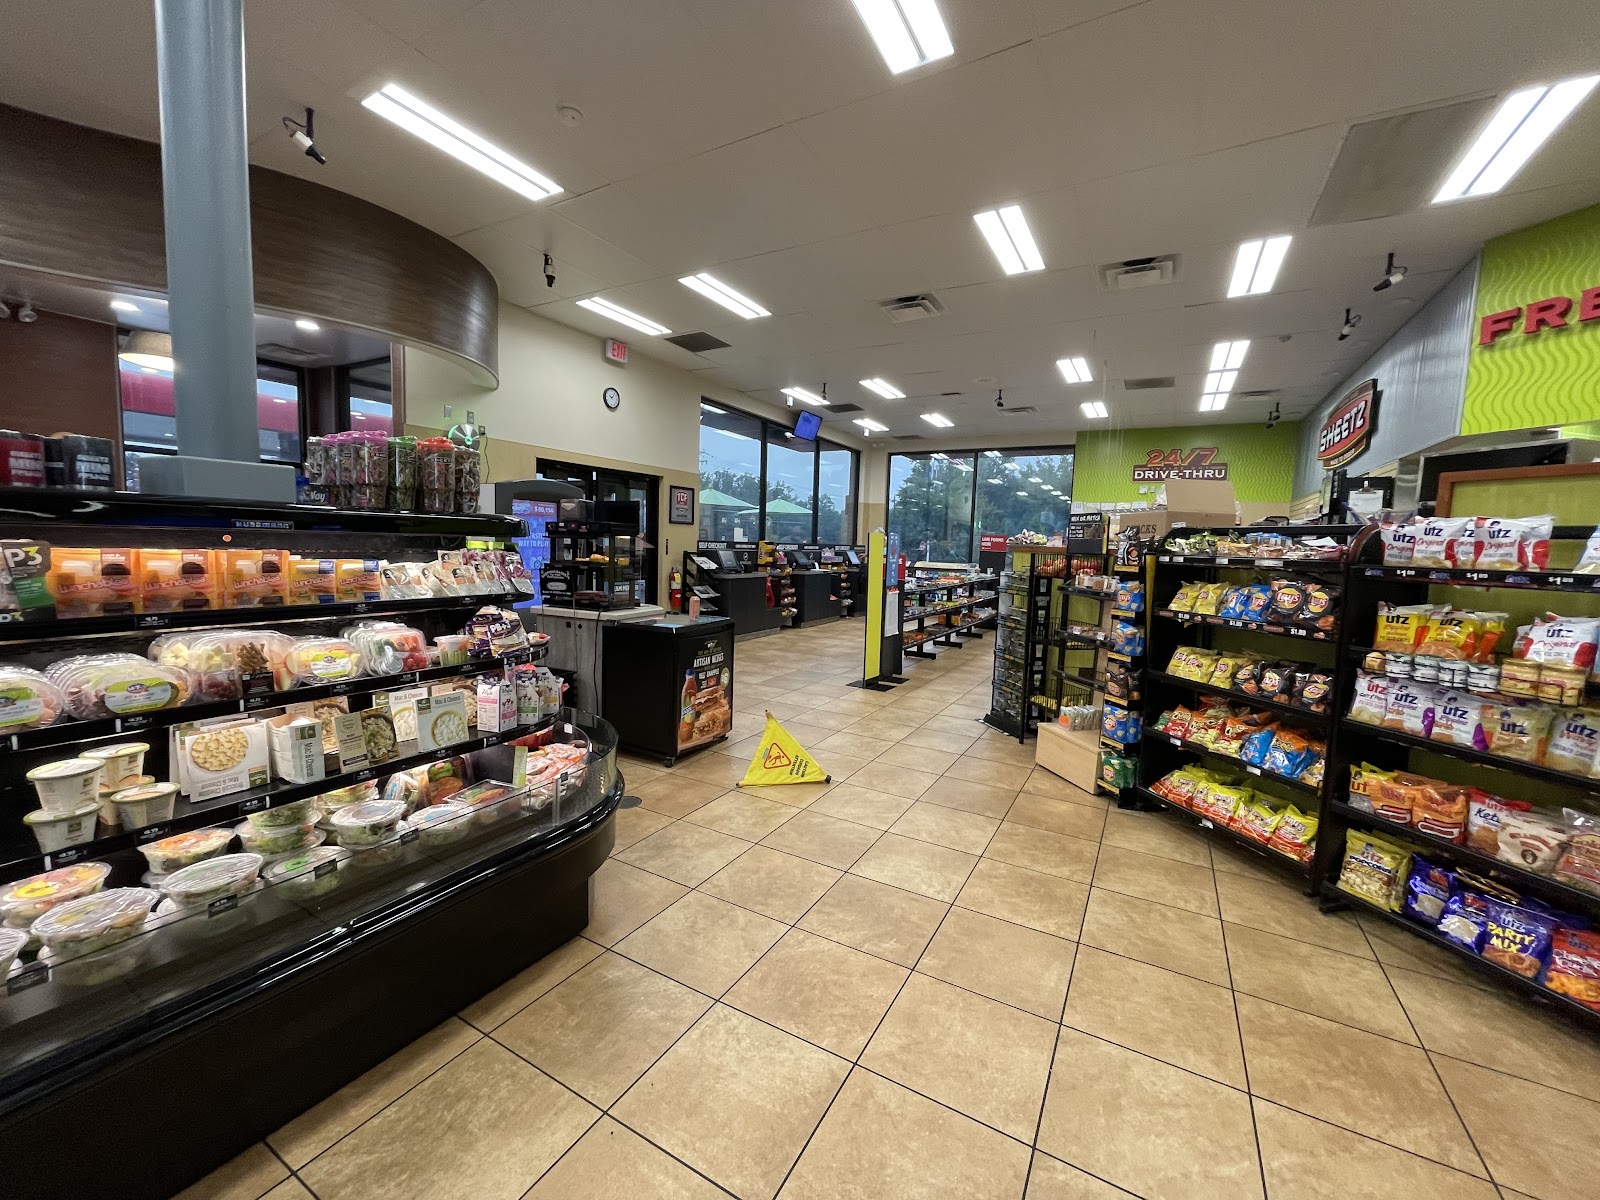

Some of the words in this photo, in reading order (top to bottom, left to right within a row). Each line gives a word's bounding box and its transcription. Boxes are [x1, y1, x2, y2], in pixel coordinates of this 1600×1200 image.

[611, 341, 627, 361] EXIT
[1320, 400, 1367, 453] SHEETZ
[1147, 447, 1218, 467] 24/7
[1134, 469, 1226, 480] DRIVE-THRU
[1392, 533, 1415, 544] utz
[1424, 526, 1443, 538] utz
[1488, 528, 1511, 539] utz
[707, 542, 728, 550] CHECKOUT
[1485, 540, 1516, 552] Original
[3, 546, 43, 568] P3
[58, 576, 129, 593] Lunchables
[144, 577, 206, 591] Lunchables
[233, 576, 280, 589] Lunchables
[1276, 589, 1302, 603] Lay's
[1385, 615, 1409, 625] utz
[1440, 618, 1464, 628] utz
[489, 620, 512, 634] PB+J
[1546, 628, 1574, 638] utz
[694, 656, 711, 668] ARTISAN
[1367, 683, 1387, 694] utz
[1395, 693, 1418, 705] utz
[1442, 705, 1469, 720] utz
[1565, 722, 1598, 740] utz
[1349, 855, 1392, 874] POPCORN
[1487, 921, 1536, 946] PARTY
[1490, 936, 1522, 954] MIX
